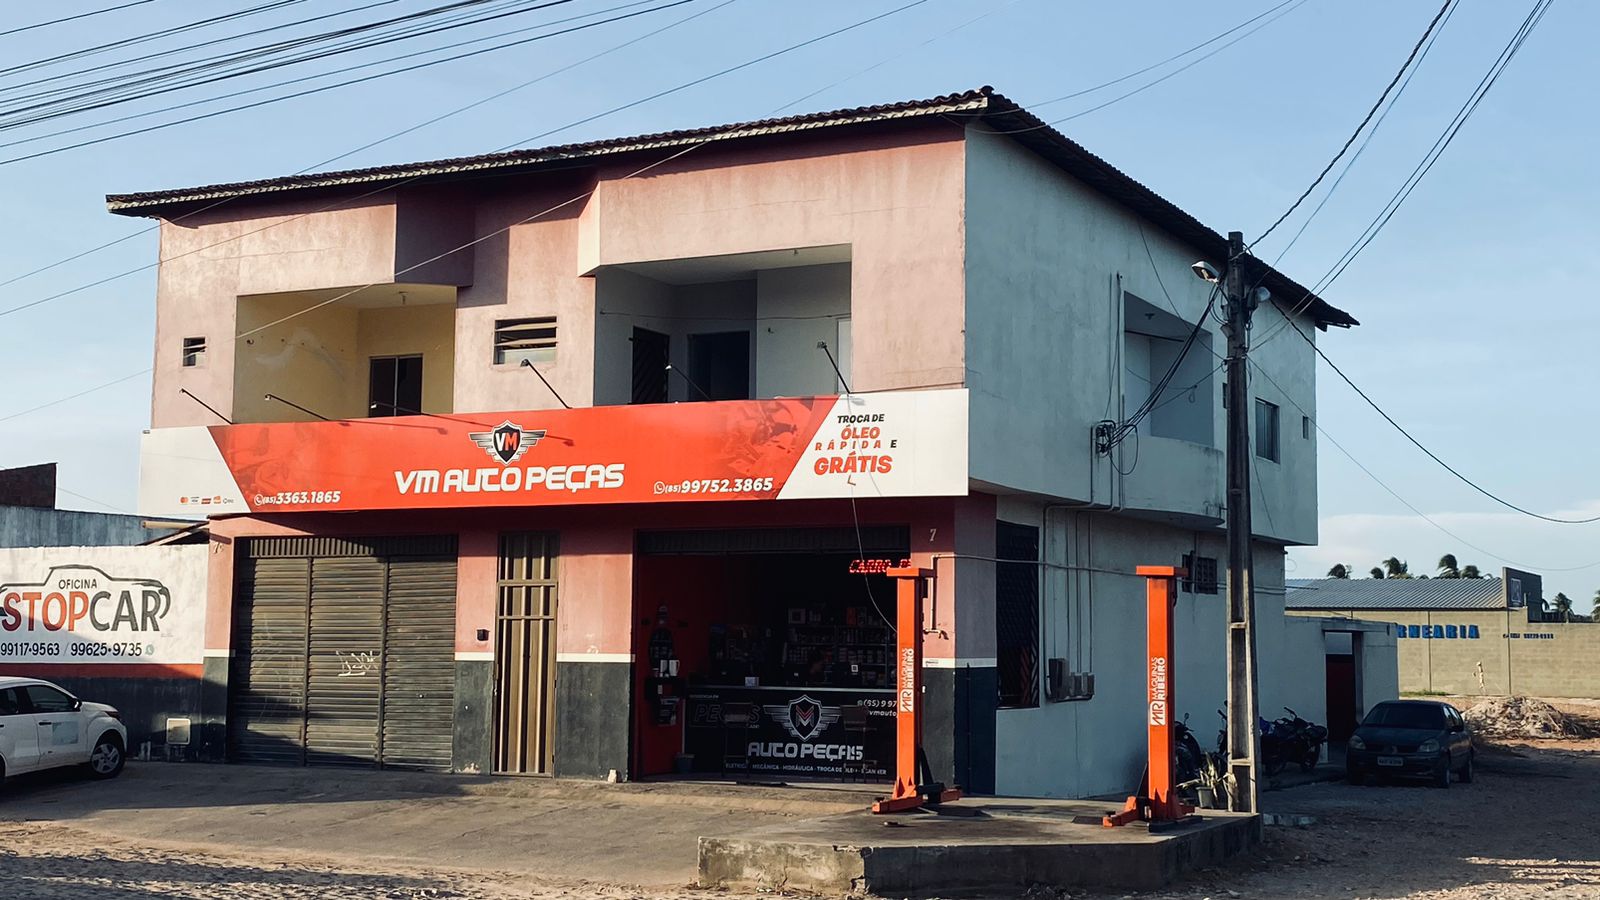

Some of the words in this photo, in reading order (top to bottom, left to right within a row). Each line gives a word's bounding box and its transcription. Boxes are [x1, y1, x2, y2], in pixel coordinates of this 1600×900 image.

[837, 414, 870, 424] TROCA
[871, 413, 885, 423] DE
[495, 431, 517, 452] VM
[840, 425, 881, 441] ÓLEO
[815, 439, 882, 451] RÁPIDA
[890, 439, 897, 449] E
[814, 451, 893, 476] GRÁTIS
[394, 469, 441, 494] VM
[442, 466, 522, 493] AUTO
[524, 463, 625, 493] PEÇAS
[58, 578, 98, 590] OFICINA
[2, 589, 160, 632] STOPCAR
[906, 647, 914, 690] RIBEIRO
[1157, 656, 1166, 702] RIBEIRO
[1151, 702, 1164, 726] MR
[748, 742, 800, 758] AUTO
[816, 765, 835, 773] TROCA
